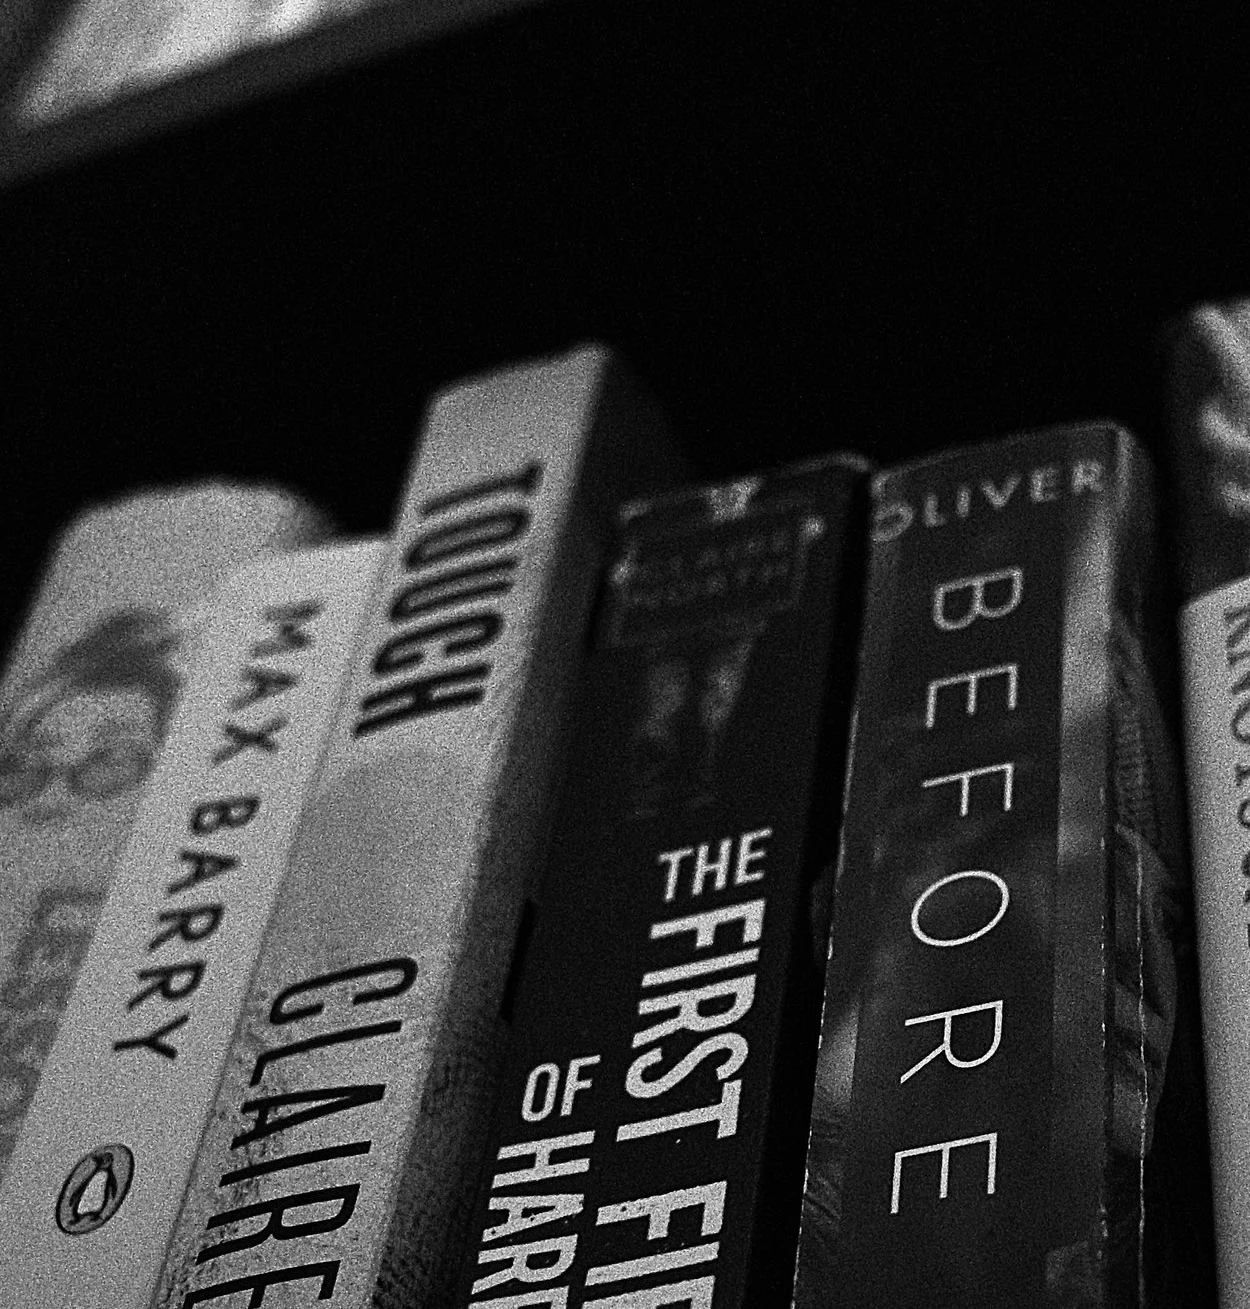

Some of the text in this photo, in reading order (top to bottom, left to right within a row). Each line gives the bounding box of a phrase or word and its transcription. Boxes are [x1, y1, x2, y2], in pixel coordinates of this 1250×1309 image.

[355, 462, 542, 738] TOUCH
[870, 459, 1104, 542] OLIVER
[112, 600, 320, 1061] MAX BARRY
[657, 827, 772, 902] THE
[889, 564, 1024, 1215] BEFORE
[520, 1054, 600, 1123] OF
[615, 897, 767, 1144] FIRST
